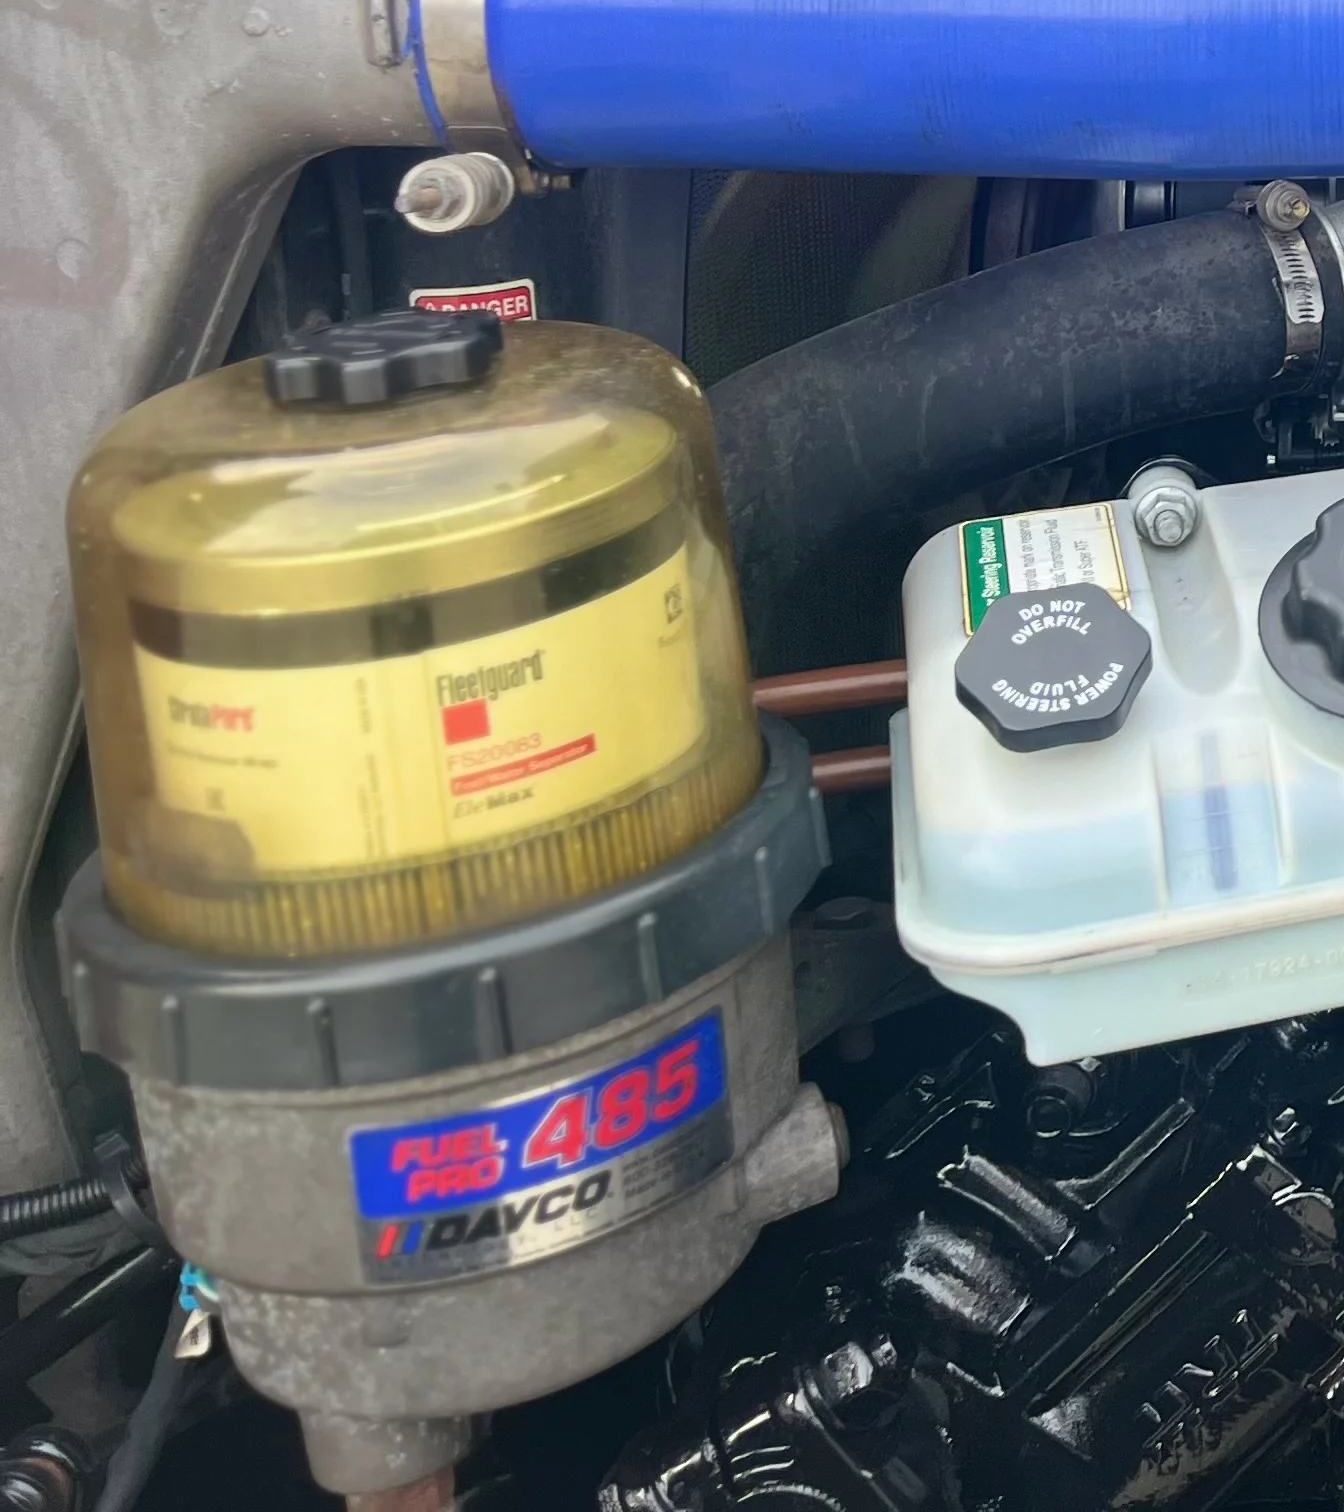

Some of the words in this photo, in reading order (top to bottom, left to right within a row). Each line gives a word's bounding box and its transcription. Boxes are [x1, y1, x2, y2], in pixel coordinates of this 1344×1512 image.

[976, 525, 997, 565] Reservoir
[1047, 533, 1065, 573] Transmission
[980, 561, 1003, 599] Steering
[1011, 614, 1092, 645] OVERFILL
[1019, 603, 1044, 621] DO
[1050, 600, 1086, 614] NOT
[436, 648, 545, 707] Fleetguard
[991, 679, 1072, 713] STEERING
[1029, 675, 1090, 697] FLUID
[1073, 662, 1124, 706] POWER
[522, 1037, 700, 1170] 485
[391, 1122, 507, 1173] FUEL
[405, 1156, 505, 1205] PRO
[426, 1169, 613, 1251] DAVCO
